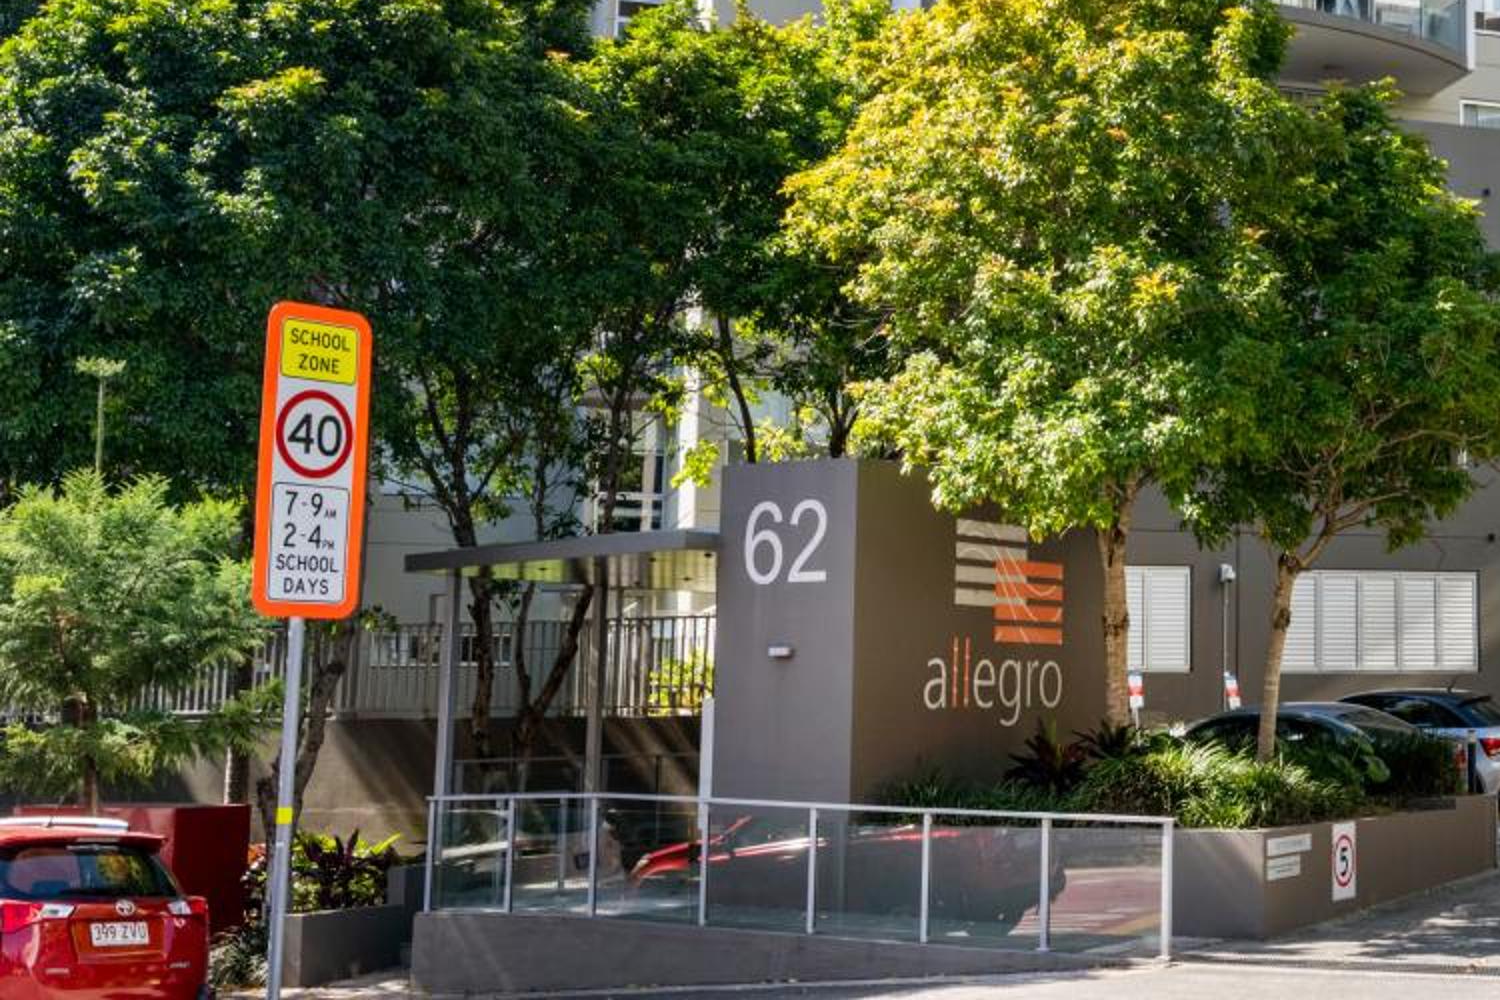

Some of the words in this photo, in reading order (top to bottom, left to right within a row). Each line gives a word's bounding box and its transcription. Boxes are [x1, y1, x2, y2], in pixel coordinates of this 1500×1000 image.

[290, 327, 351, 353] SCHOOL
[298, 353, 340, 375] ZONE
[287, 413, 343, 457] 40
[744, 498, 827, 585] 62
[276, 553, 339, 573] SCHOOL
[283, 576, 329, 595] DAYS
[923, 635, 1063, 727] allegro
[1339, 846, 1349, 877] 5
